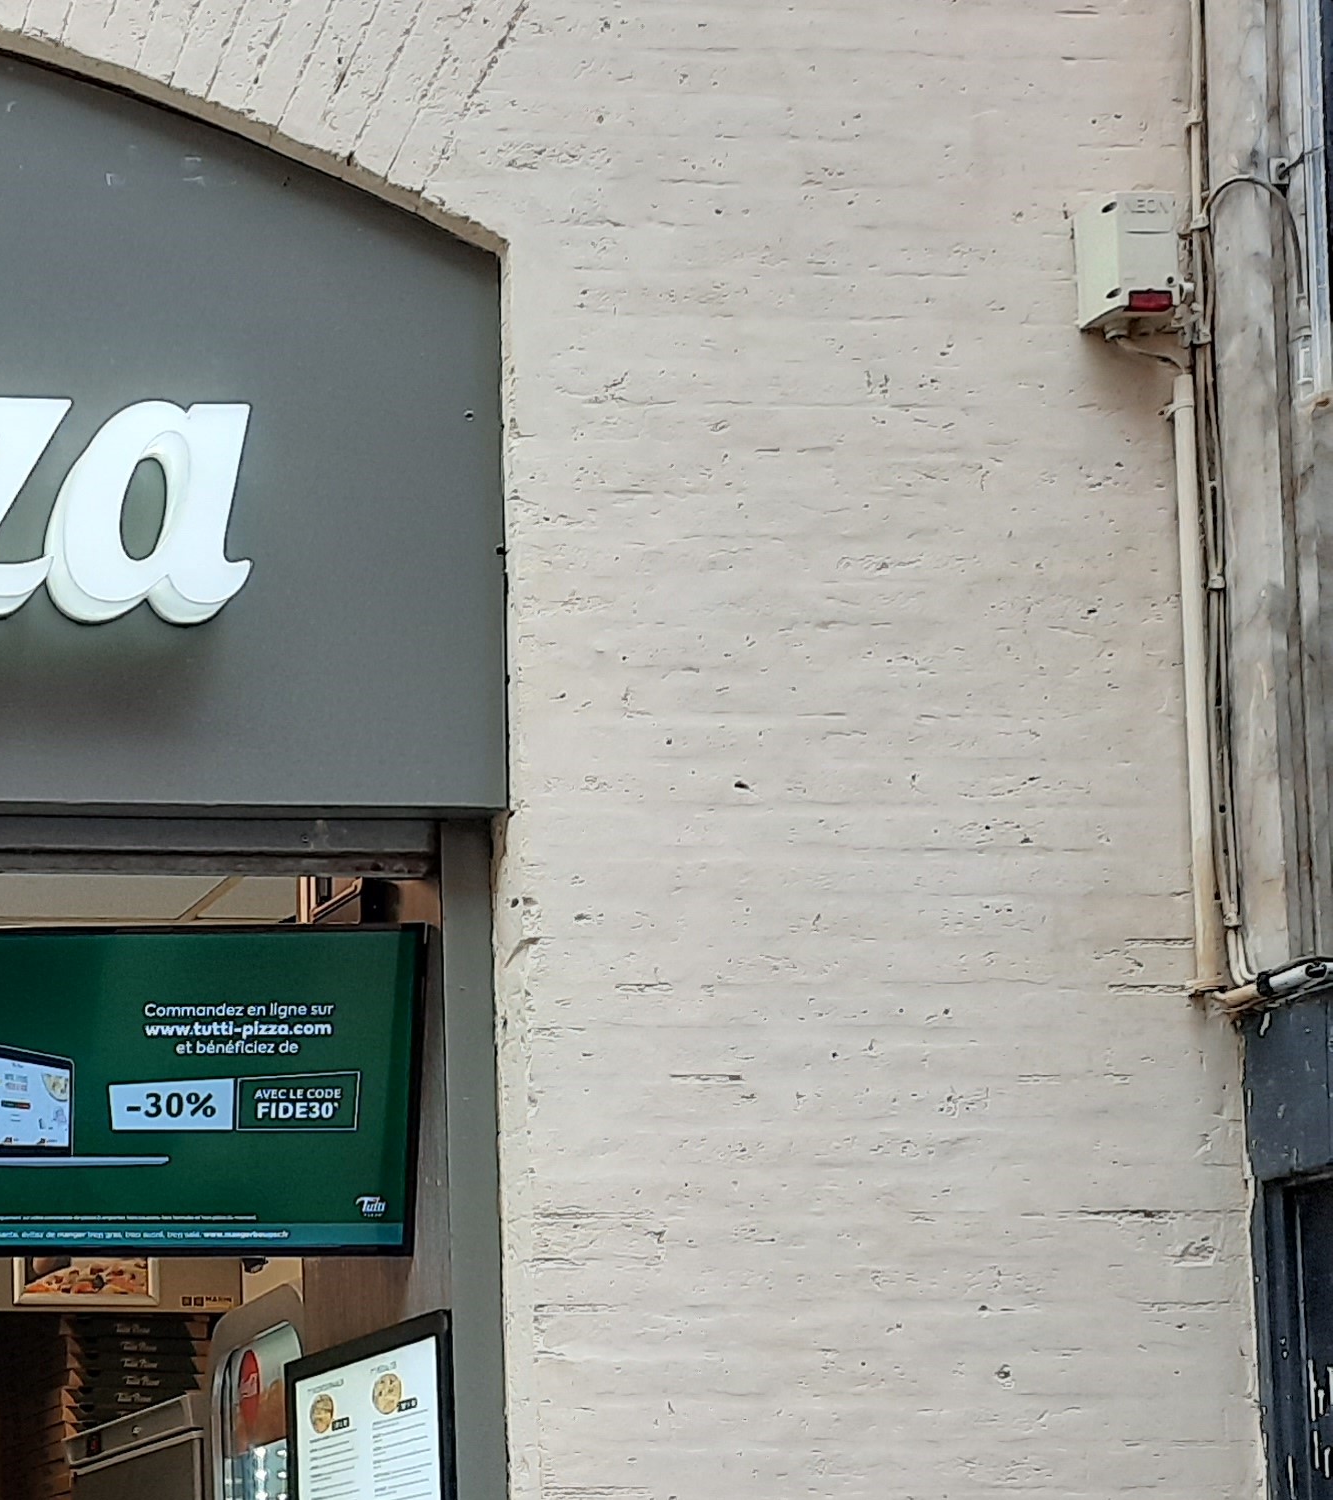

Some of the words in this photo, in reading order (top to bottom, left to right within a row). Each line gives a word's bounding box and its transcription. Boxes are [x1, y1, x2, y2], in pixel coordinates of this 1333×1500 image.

[144, 1004, 243, 1017] Commandez
[247, 1006, 266, 1016] en
[270, 1003, 307, 1019] ligne
[311, 1005, 334, 1015] sur
[145, 1021, 332, 1038] www.tutti-pizza.com
[175, 1043, 192, 1054] et
[196, 1041, 275, 1054] bénéficiez
[278, 1041, 299, 1053] de
[254, 1089, 286, 1099] AVEC
[289, 1089, 304, 1099] LE
[306, 1088, 341, 1098] CODE
[127, 1092, 216, 1118] -30%
